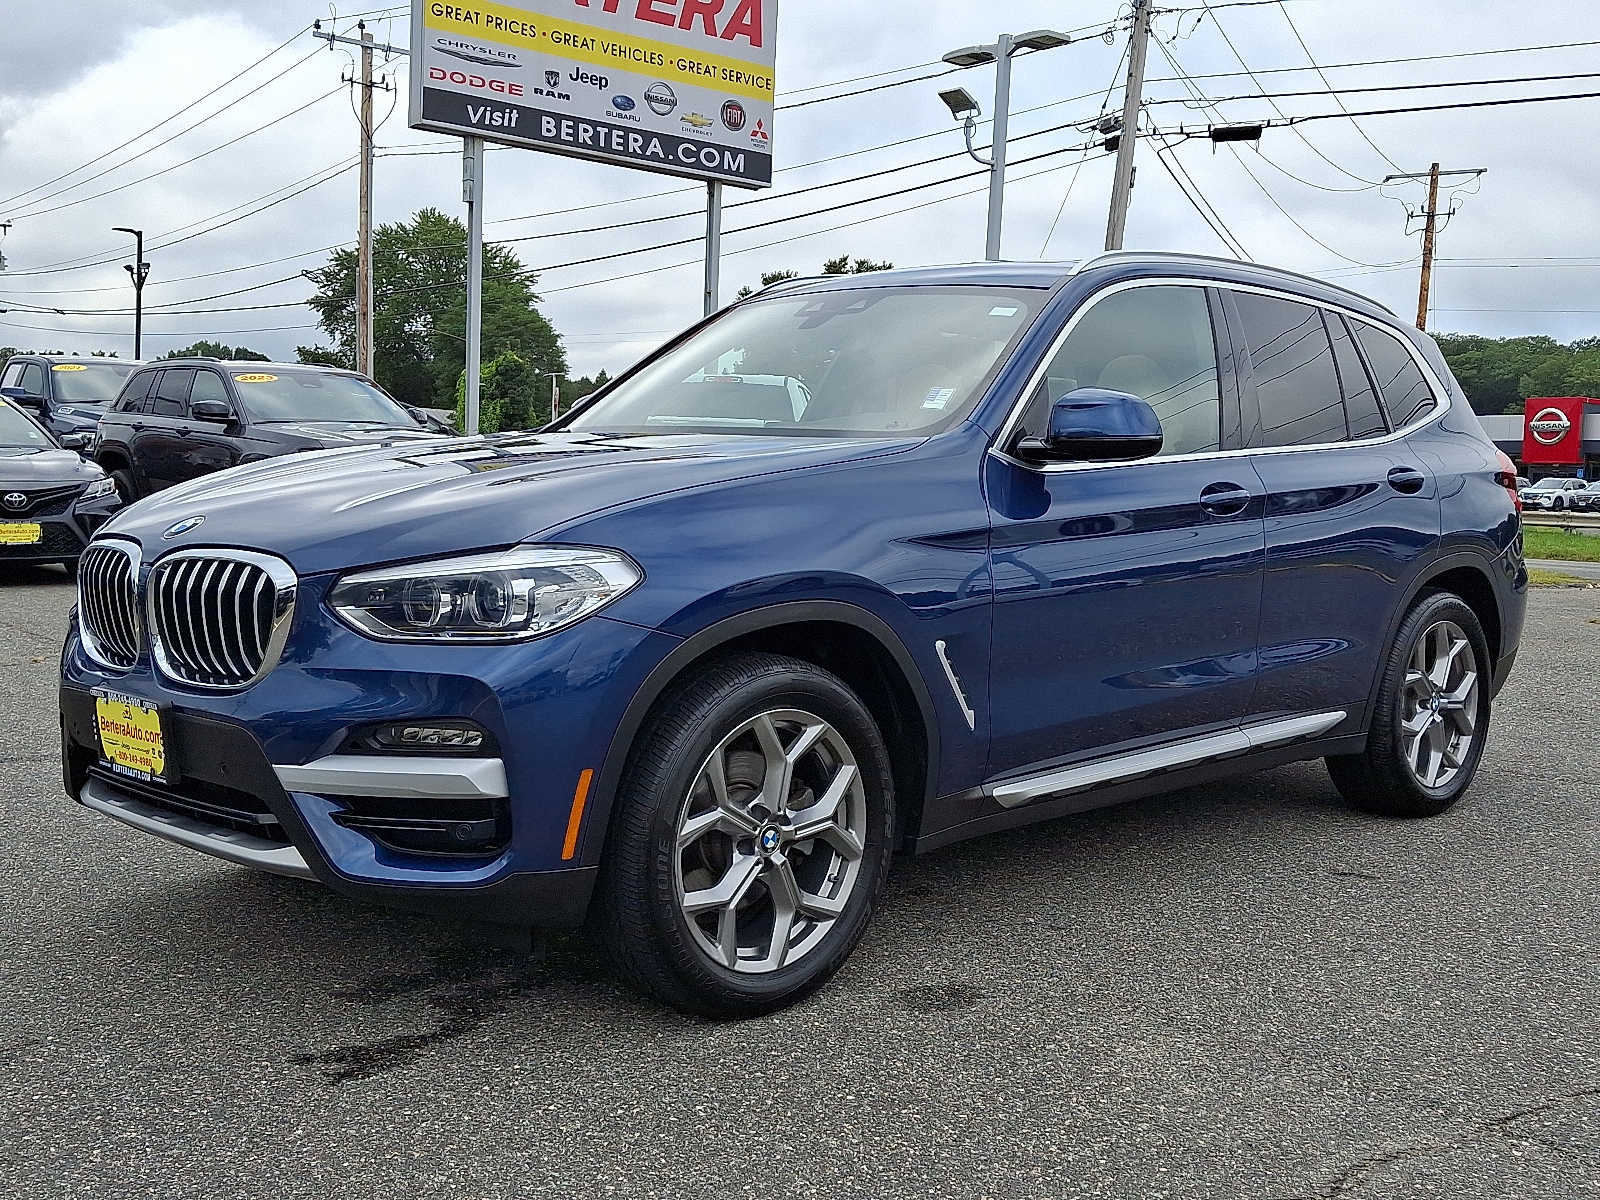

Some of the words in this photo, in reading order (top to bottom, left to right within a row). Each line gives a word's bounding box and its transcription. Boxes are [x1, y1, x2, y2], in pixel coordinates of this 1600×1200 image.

[431, 3, 480, 25] GREAT
[486, 14, 537, 38] PRICES
[551, 30, 596, 52] GREAT
[601, 41, 664, 66] VEHICLES
[676, 58, 718, 78] GREAT
[722, 68, 772, 90] SERVICE
[437, 38, 518, 61] CHRYSLER
[429, 67, 524, 97] DODGE
[569, 67, 609, 90] Jeep
[534, 87, 571, 101] RAM
[646, 93, 676, 105] NISSAN
[606, 110, 641, 123] SUBARU
[727, 108, 742, 125] FIAT
[466, 104, 519, 128] Visit
[541, 115, 745, 173] BERTERA.COM
[681, 126, 713, 137] CHEVROLET
[1531, 422, 1566, 431] NISSAN
